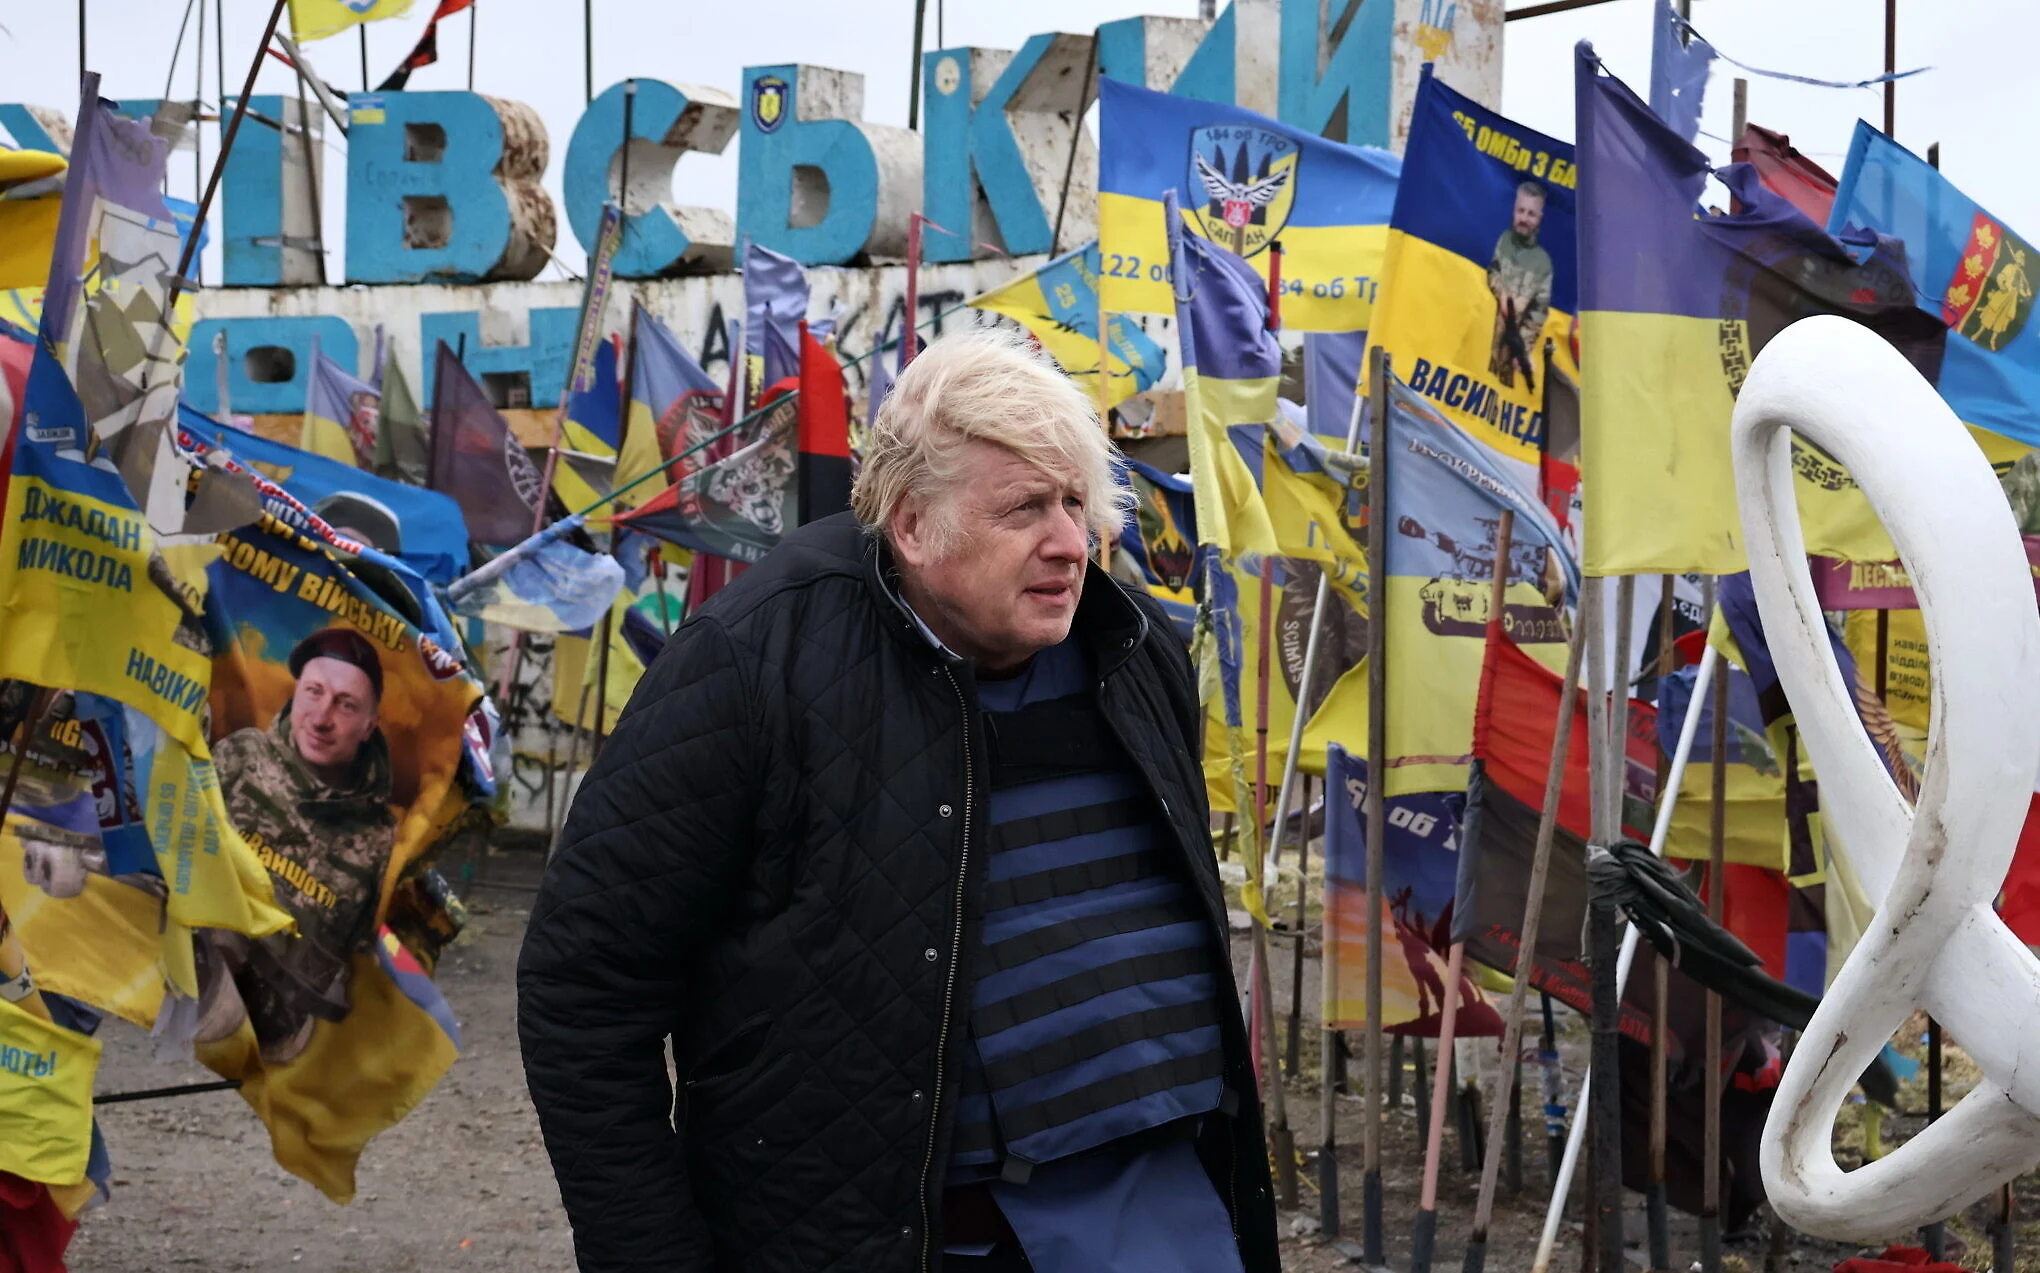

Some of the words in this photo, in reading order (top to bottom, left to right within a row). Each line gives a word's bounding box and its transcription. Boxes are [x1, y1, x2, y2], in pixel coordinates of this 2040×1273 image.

[1207, 220, 1266, 246] САПАН
[1312, 277, 1345, 299] об
[20, 486, 141, 552] ДЖАДАН
[17, 537, 133, 593] МИКОЛА
[125, 648, 207, 716] НАВІКИ
